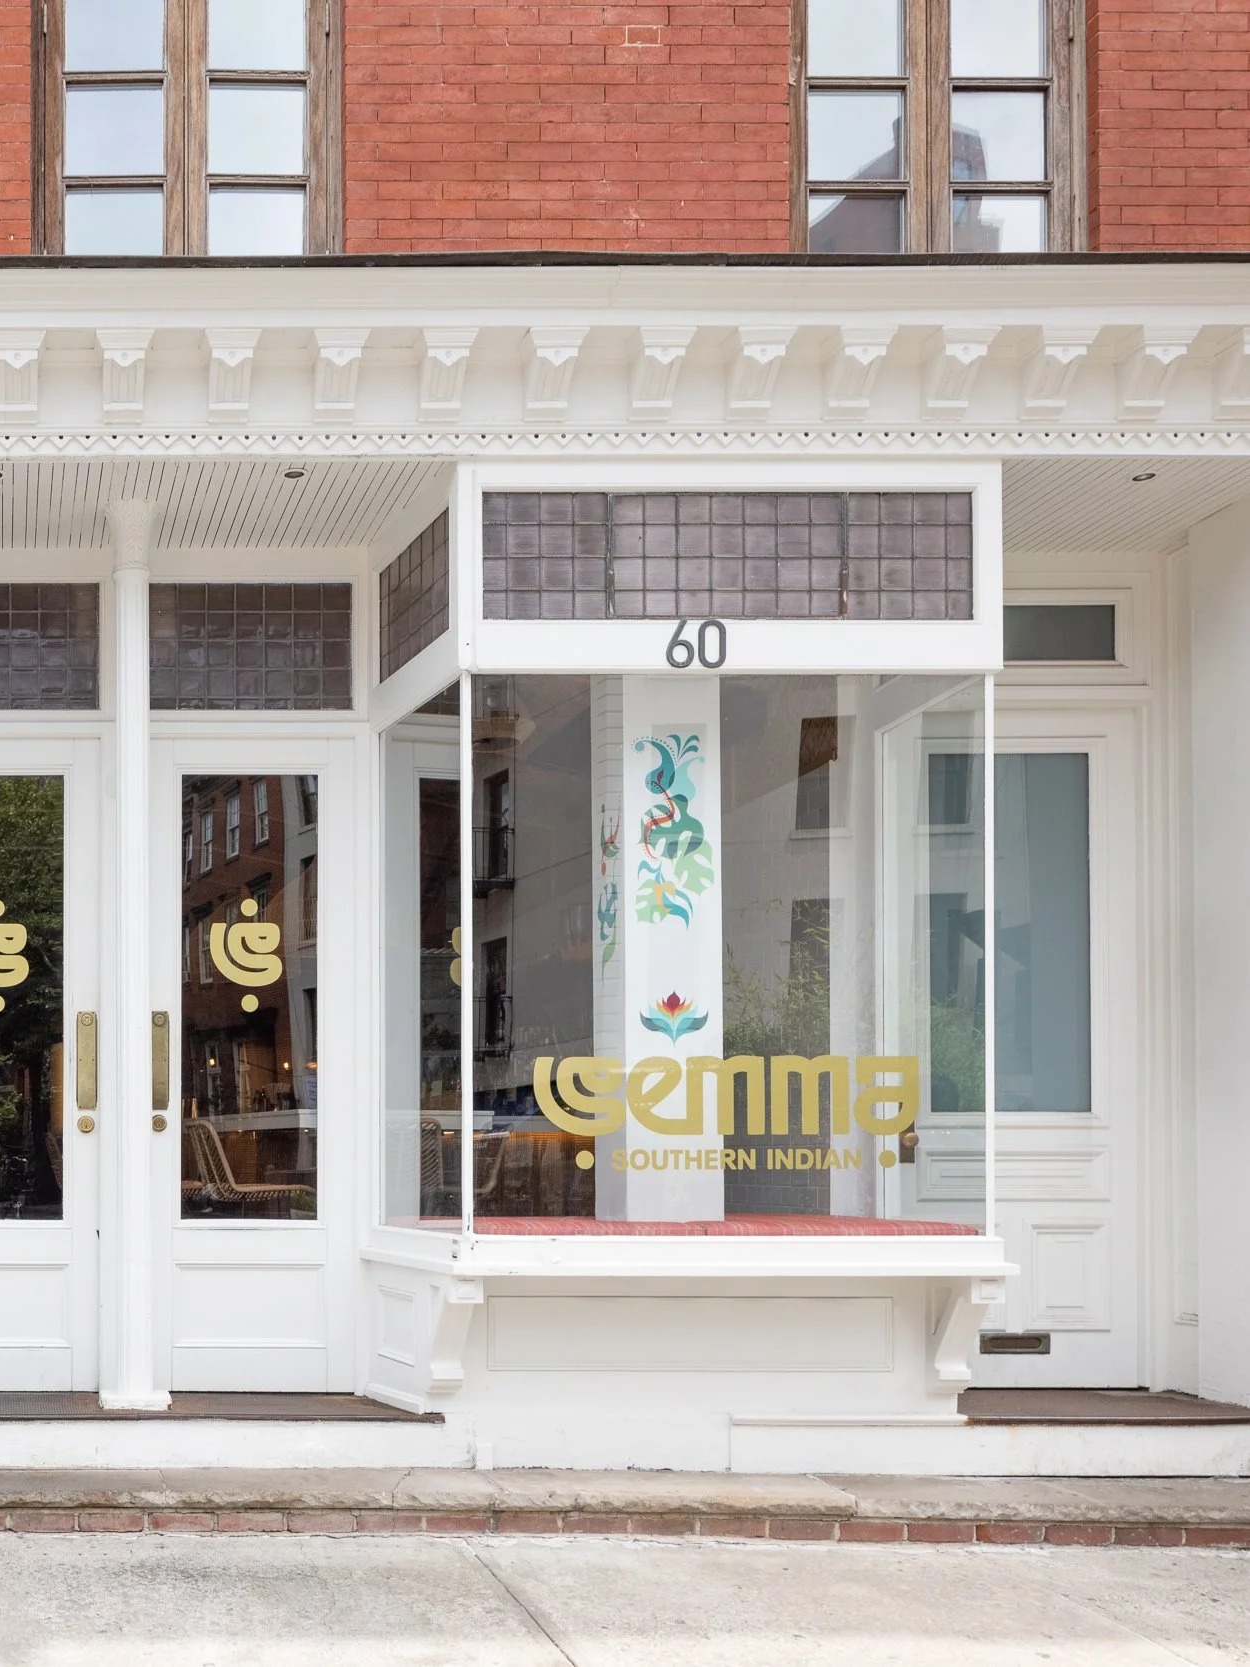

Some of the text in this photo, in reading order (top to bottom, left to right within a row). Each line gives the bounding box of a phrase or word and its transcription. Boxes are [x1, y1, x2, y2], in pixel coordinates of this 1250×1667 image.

[665, 617, 727, 668] 60
[611, 1149, 862, 1171] SOUTHERN INDIAN
